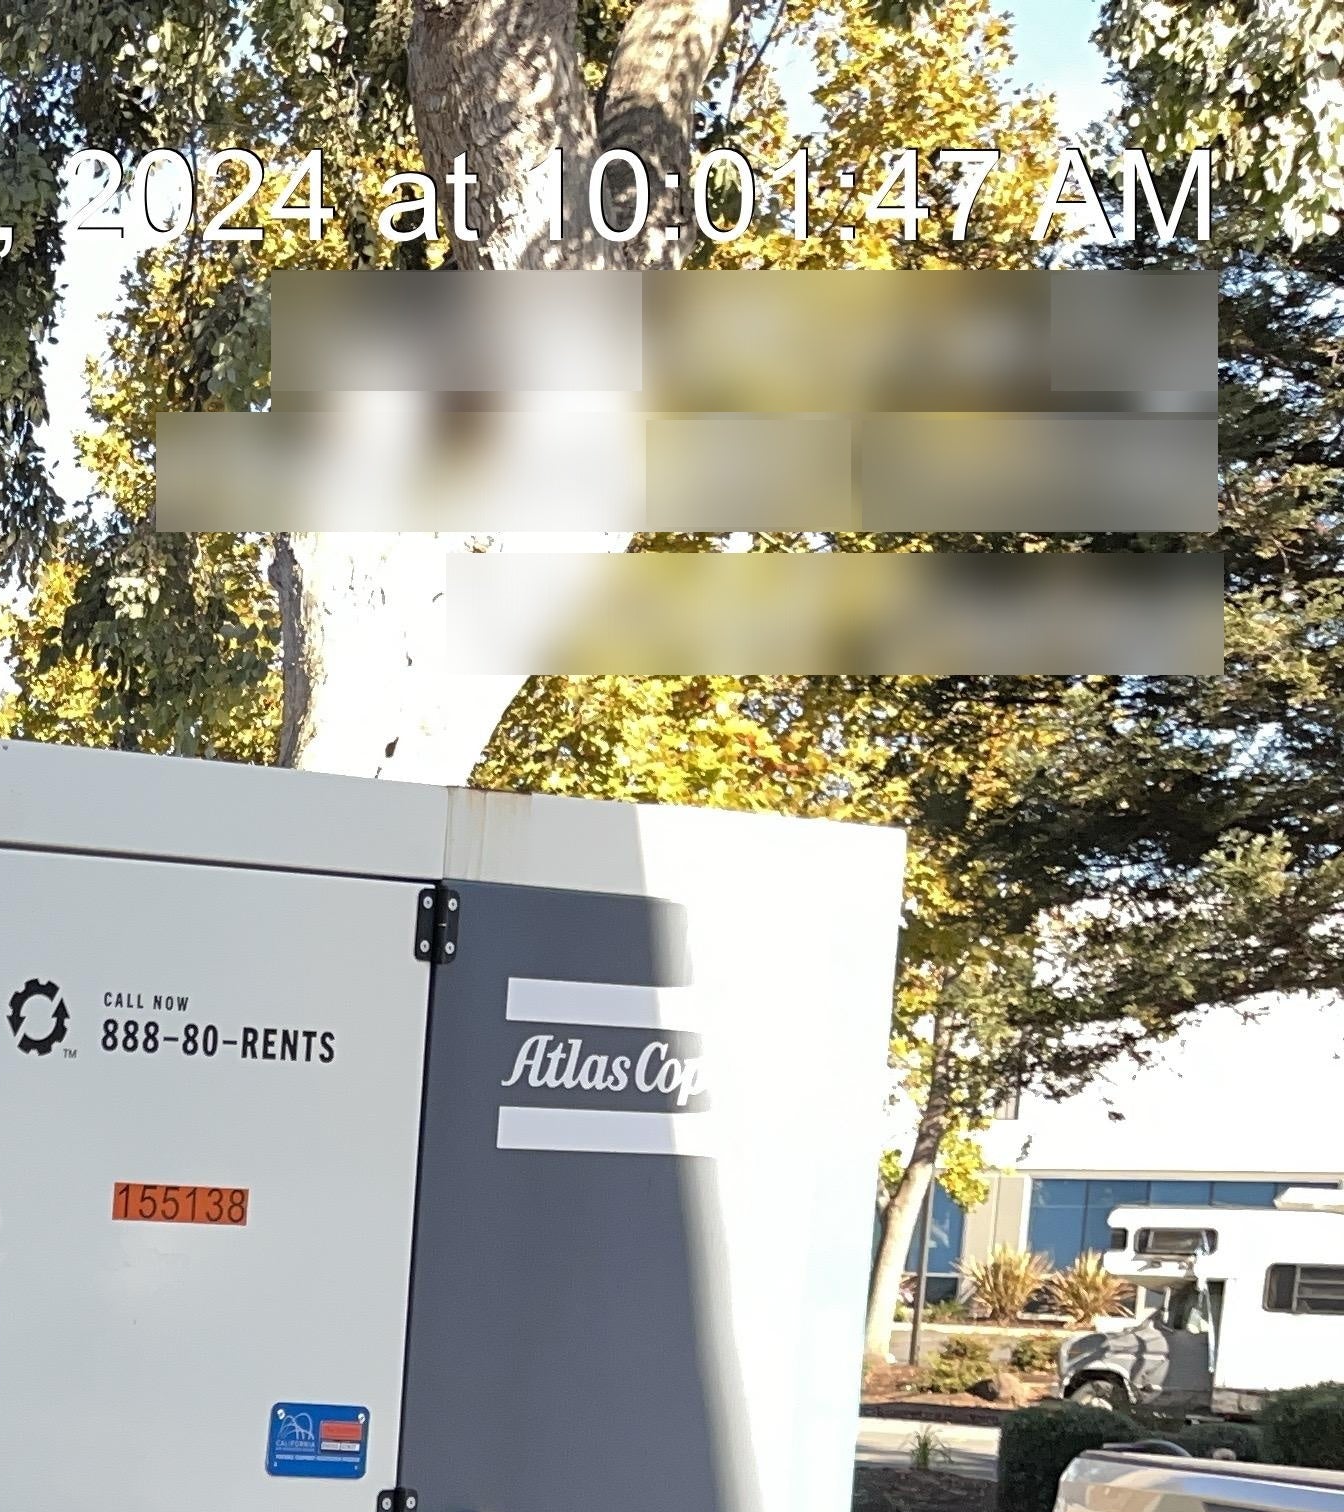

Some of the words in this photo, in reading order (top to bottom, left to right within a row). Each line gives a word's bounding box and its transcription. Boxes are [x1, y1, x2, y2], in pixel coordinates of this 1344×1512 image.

[103, 991, 145, 1010] CALL
[153, 995, 190, 1012] NOW
[100, 1018, 336, 1064] 888-80-RENTS
[500, 1034, 632, 1092] Atlas
[118, 1183, 247, 1224] 155138
